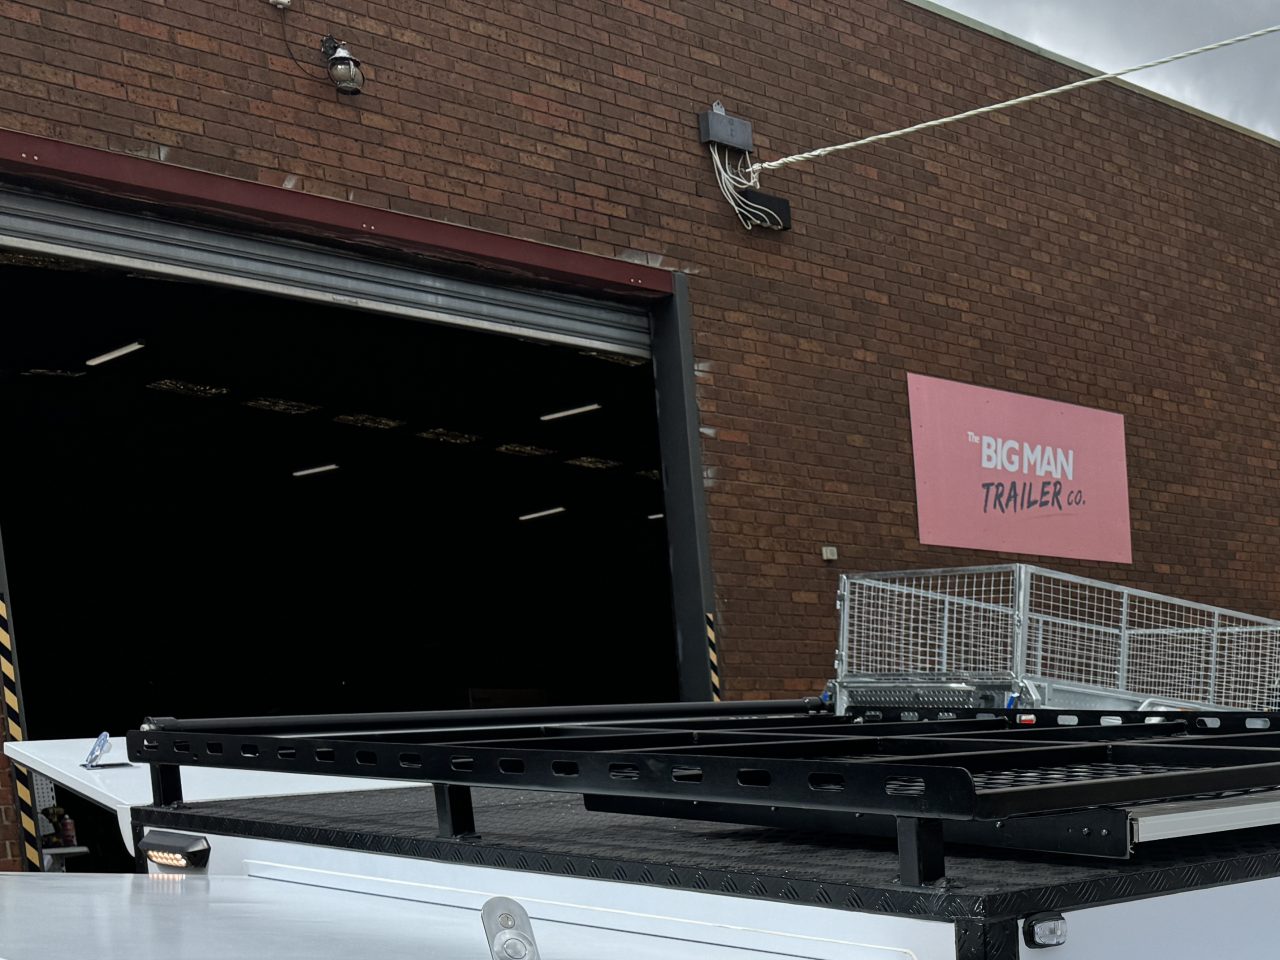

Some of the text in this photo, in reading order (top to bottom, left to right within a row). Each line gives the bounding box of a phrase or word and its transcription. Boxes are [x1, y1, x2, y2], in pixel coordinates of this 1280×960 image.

[967, 431, 1074, 480] The BIG MAN
[981, 480, 1063, 514] TRAILER
